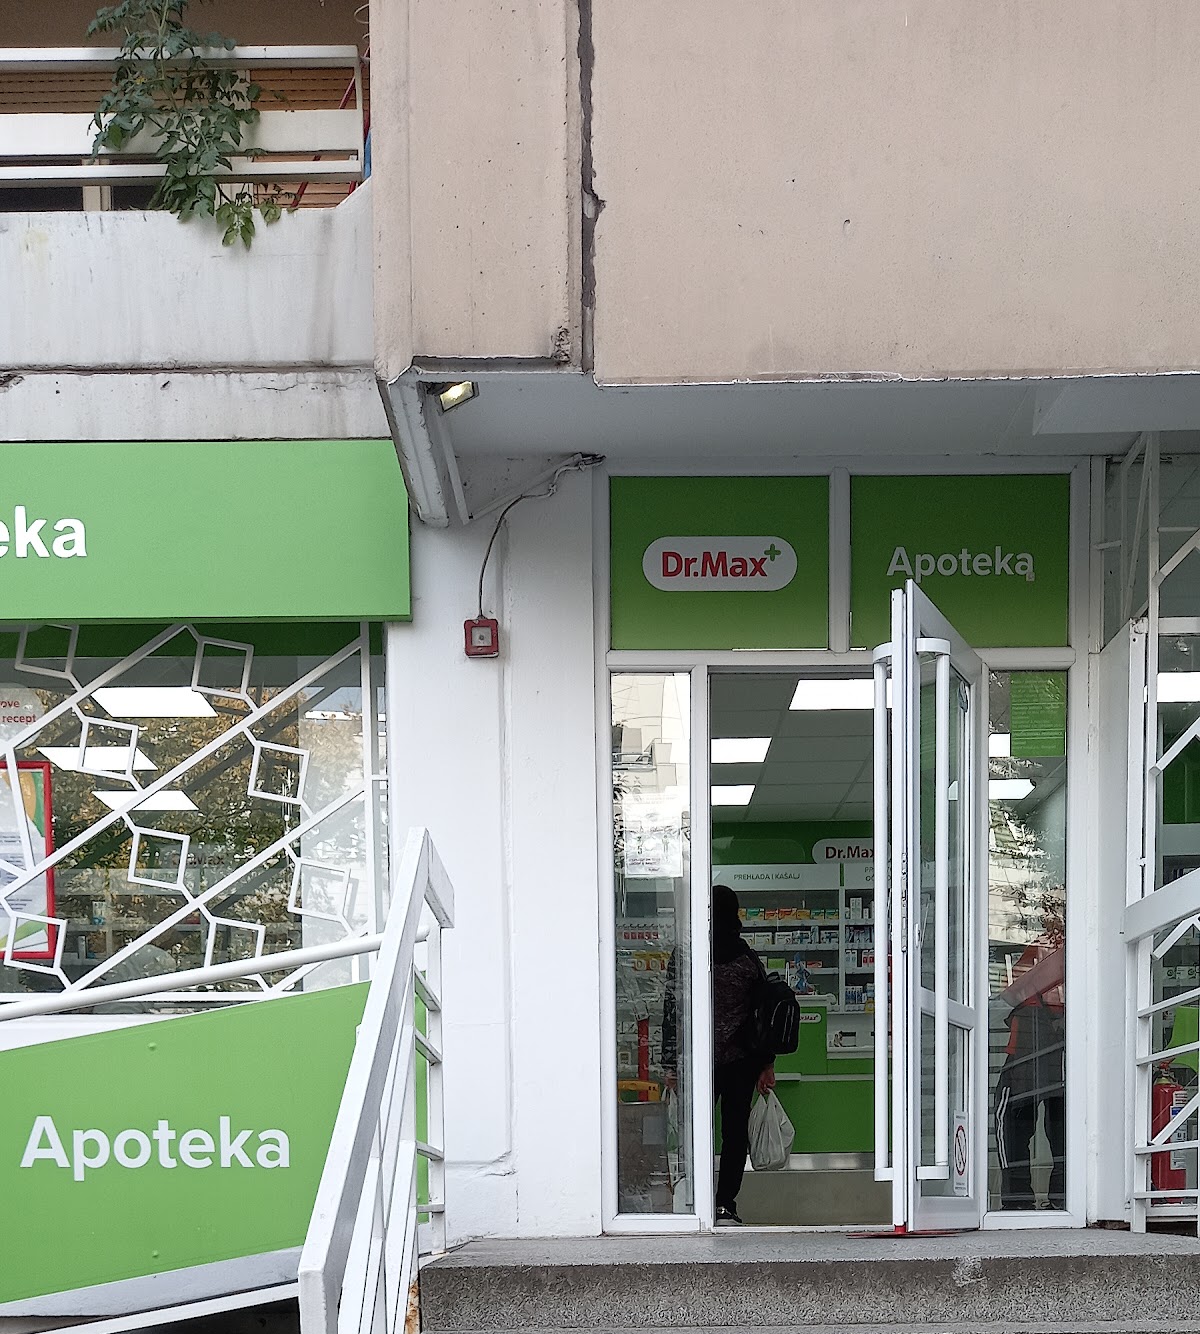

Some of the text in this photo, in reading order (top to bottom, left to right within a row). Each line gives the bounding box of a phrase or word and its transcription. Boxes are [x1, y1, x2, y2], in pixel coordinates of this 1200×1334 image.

[662, 551, 768, 577] Dr.Max
[886, 546, 1034, 584] Apoteka
[2, 714, 37, 725] recept
[20, 1115, 290, 1181] Apoteka
